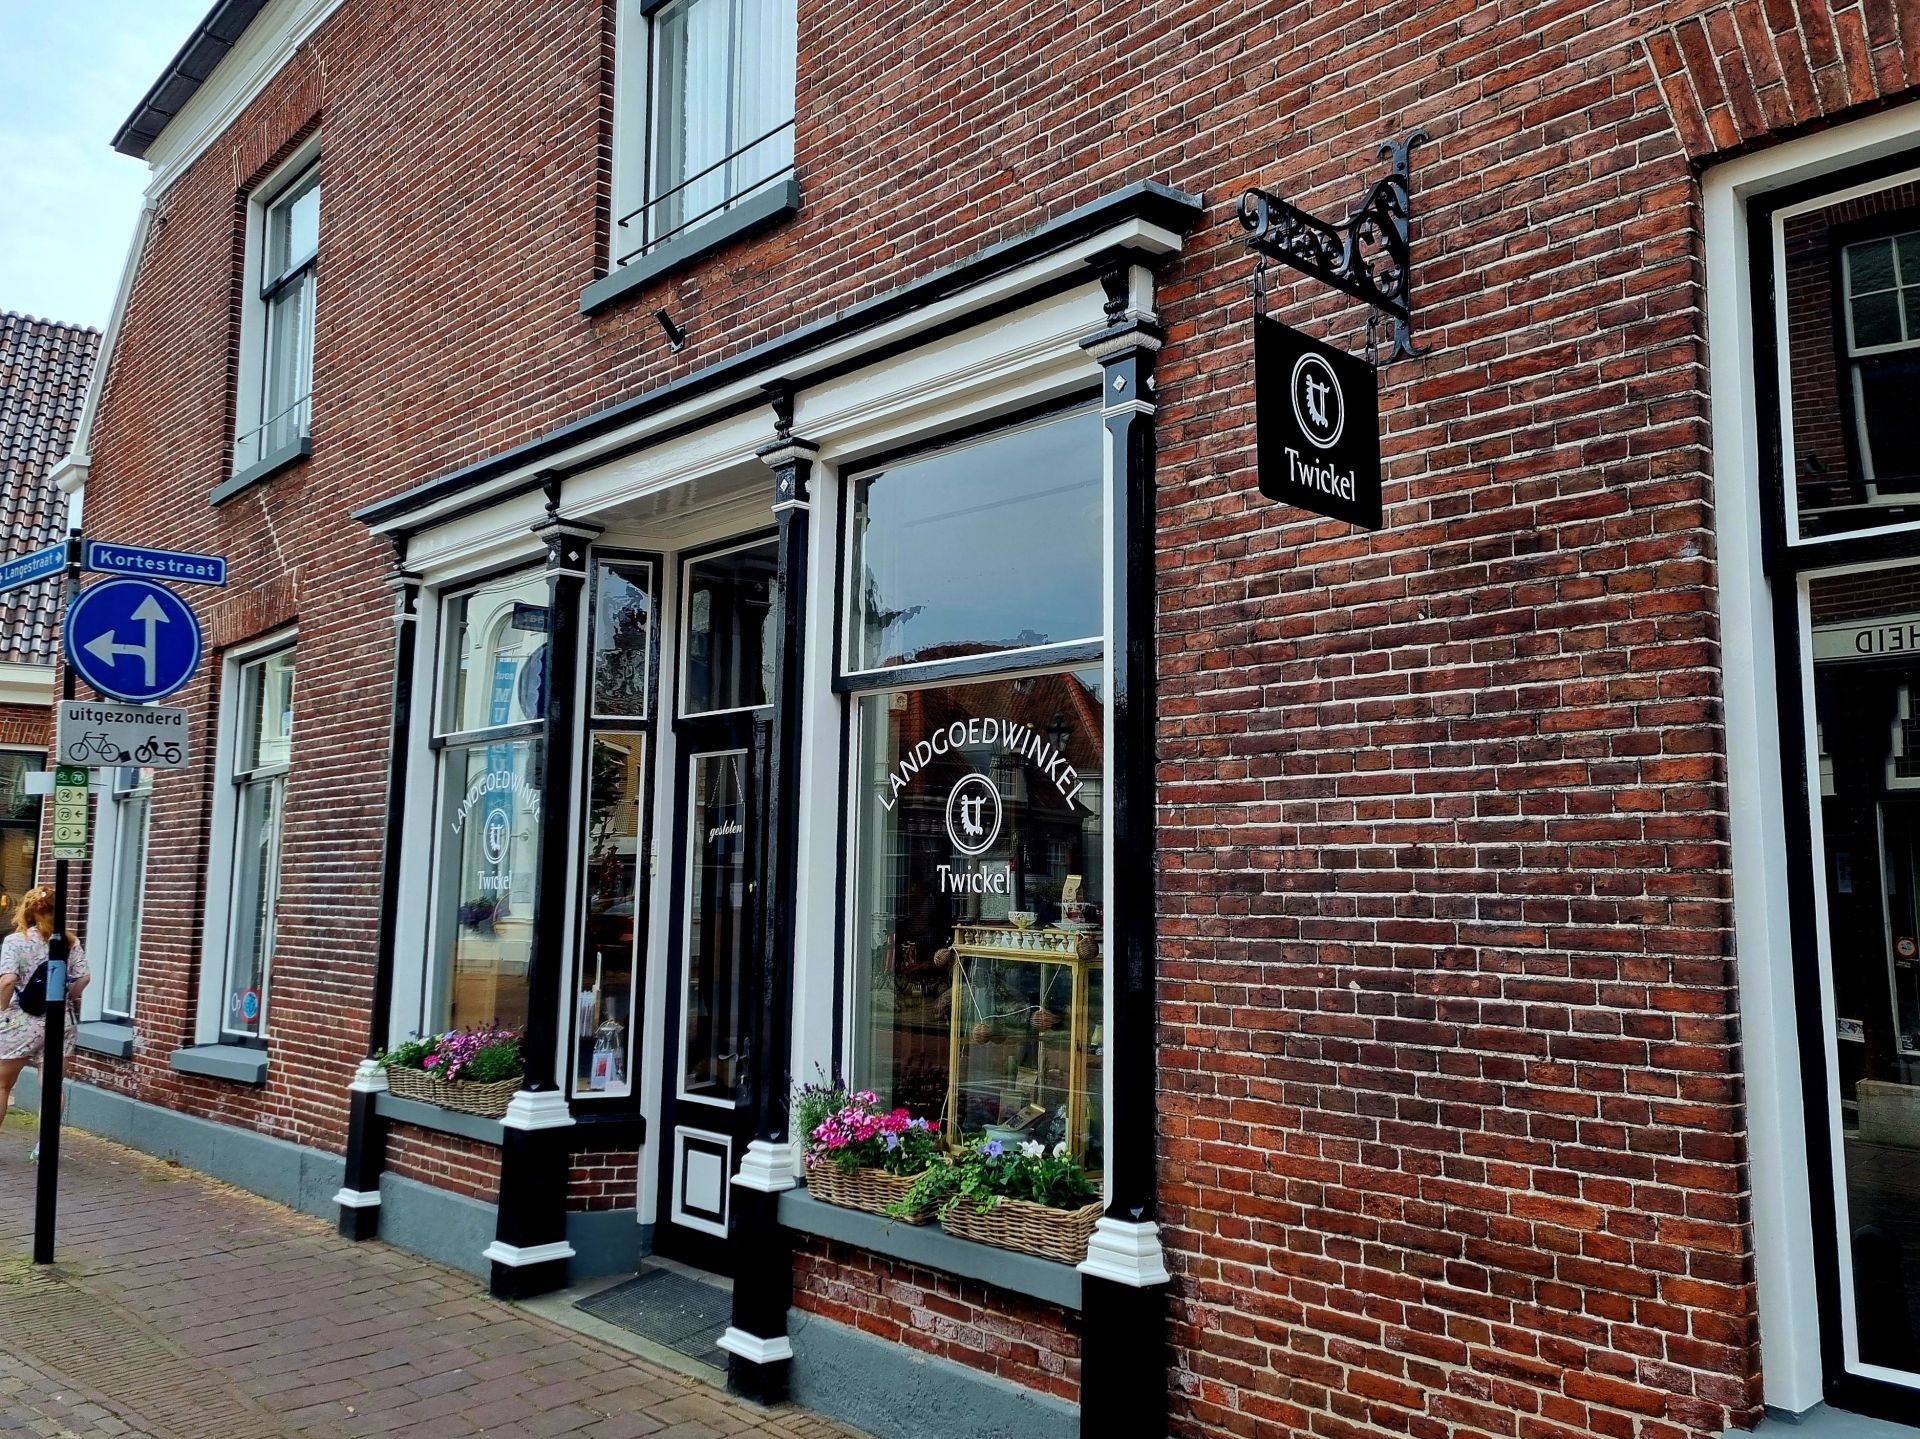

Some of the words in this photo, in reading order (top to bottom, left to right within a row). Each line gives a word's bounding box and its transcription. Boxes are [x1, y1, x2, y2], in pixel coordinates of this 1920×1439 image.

[1284, 446, 1356, 502] Twickel
[4, 552, 54, 580] Langestraat
[100, 549, 215, 577] Kortestraat
[69, 707, 182, 726] uitgezonderd
[877, 717, 1085, 812] LANDGOEDWINKEL
[73, 773, 82, 782] 76
[61, 790, 70, 800] 74
[60, 810, 70, 820] 73
[61, 829, 66, 838] 4
[708, 819, 743, 844] gesloten
[477, 870, 512, 890] Twickel
[936, 864, 1011, 894] Twickel
